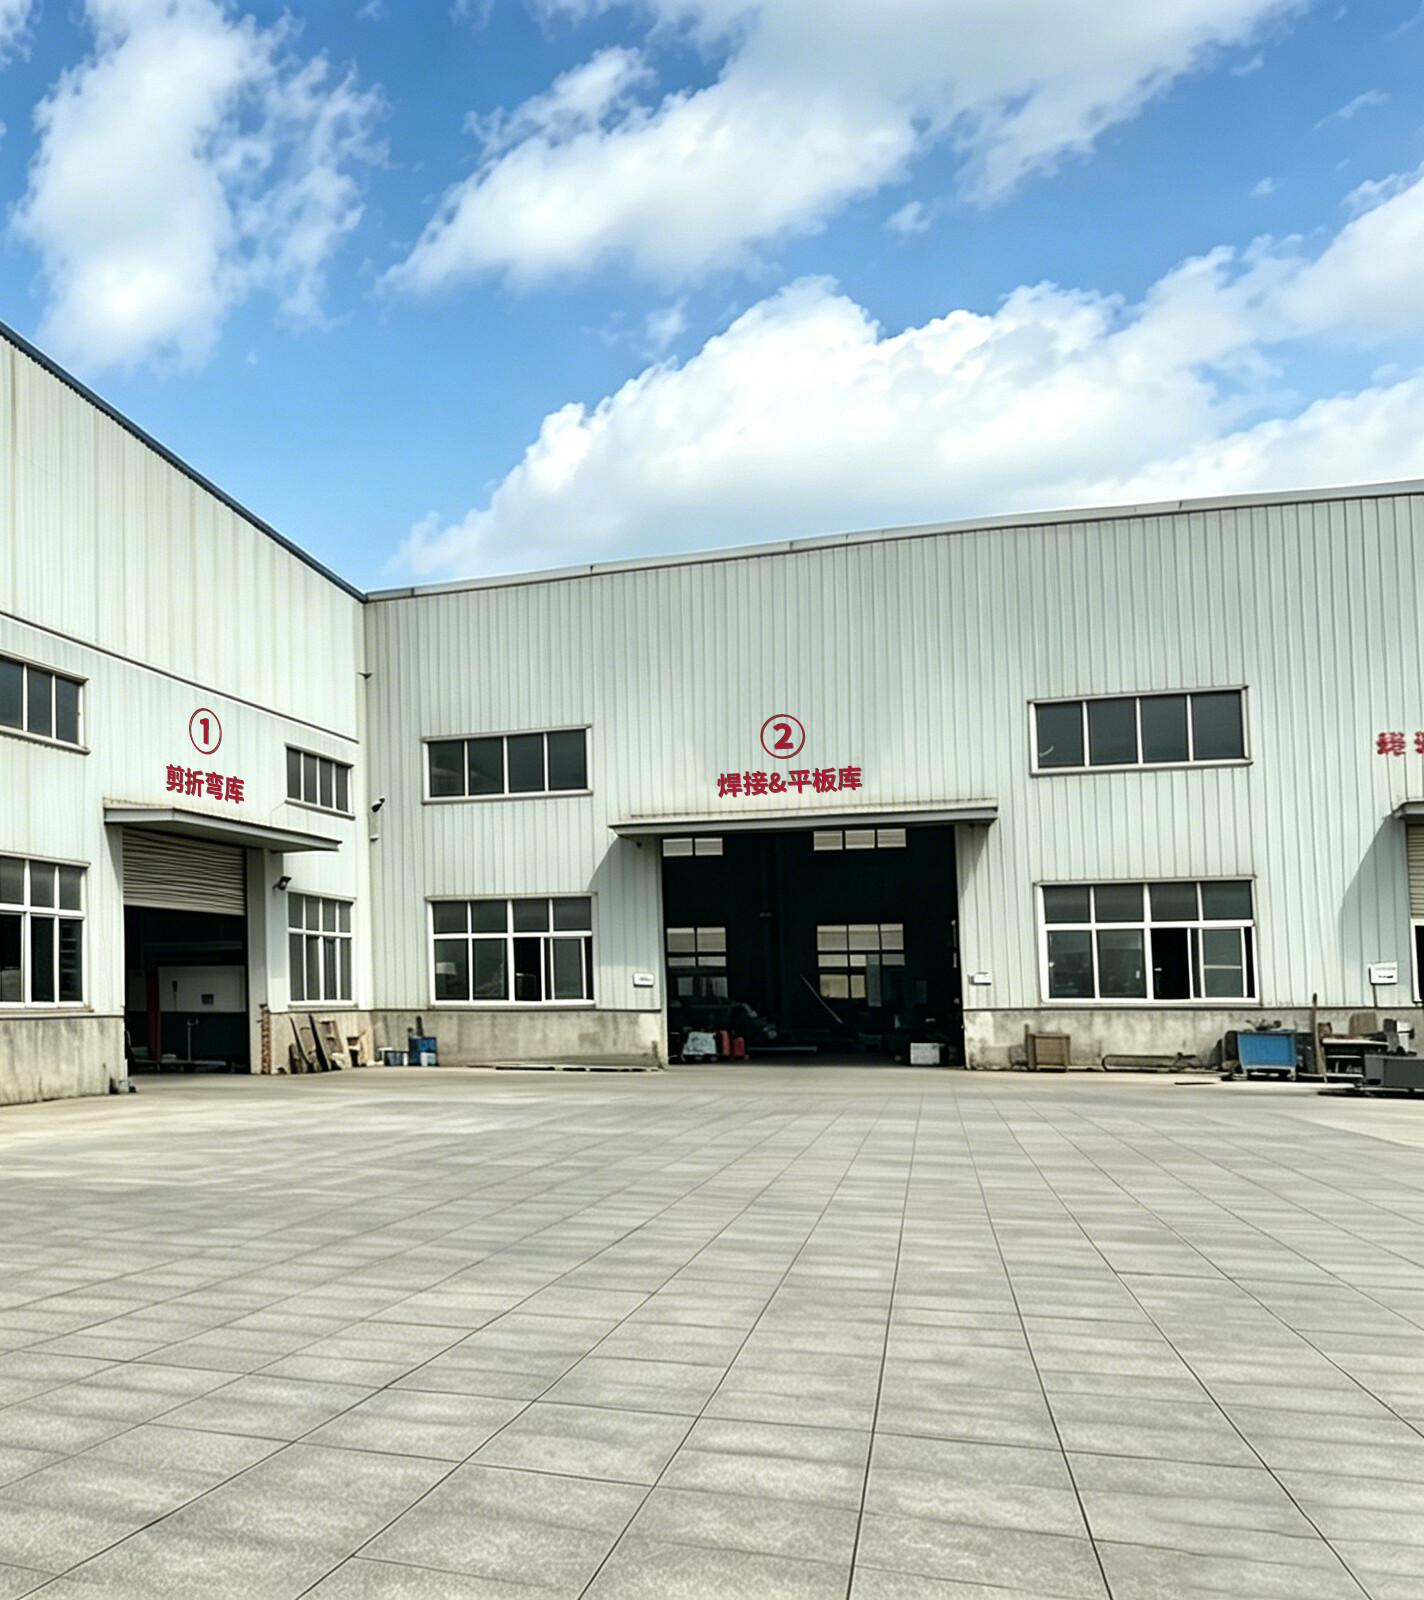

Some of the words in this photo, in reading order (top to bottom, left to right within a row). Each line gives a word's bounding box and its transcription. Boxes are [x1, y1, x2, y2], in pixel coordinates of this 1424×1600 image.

[165, 763, 245, 805] 剪折弯库
[716, 765, 863, 799] 焊接&平板库
